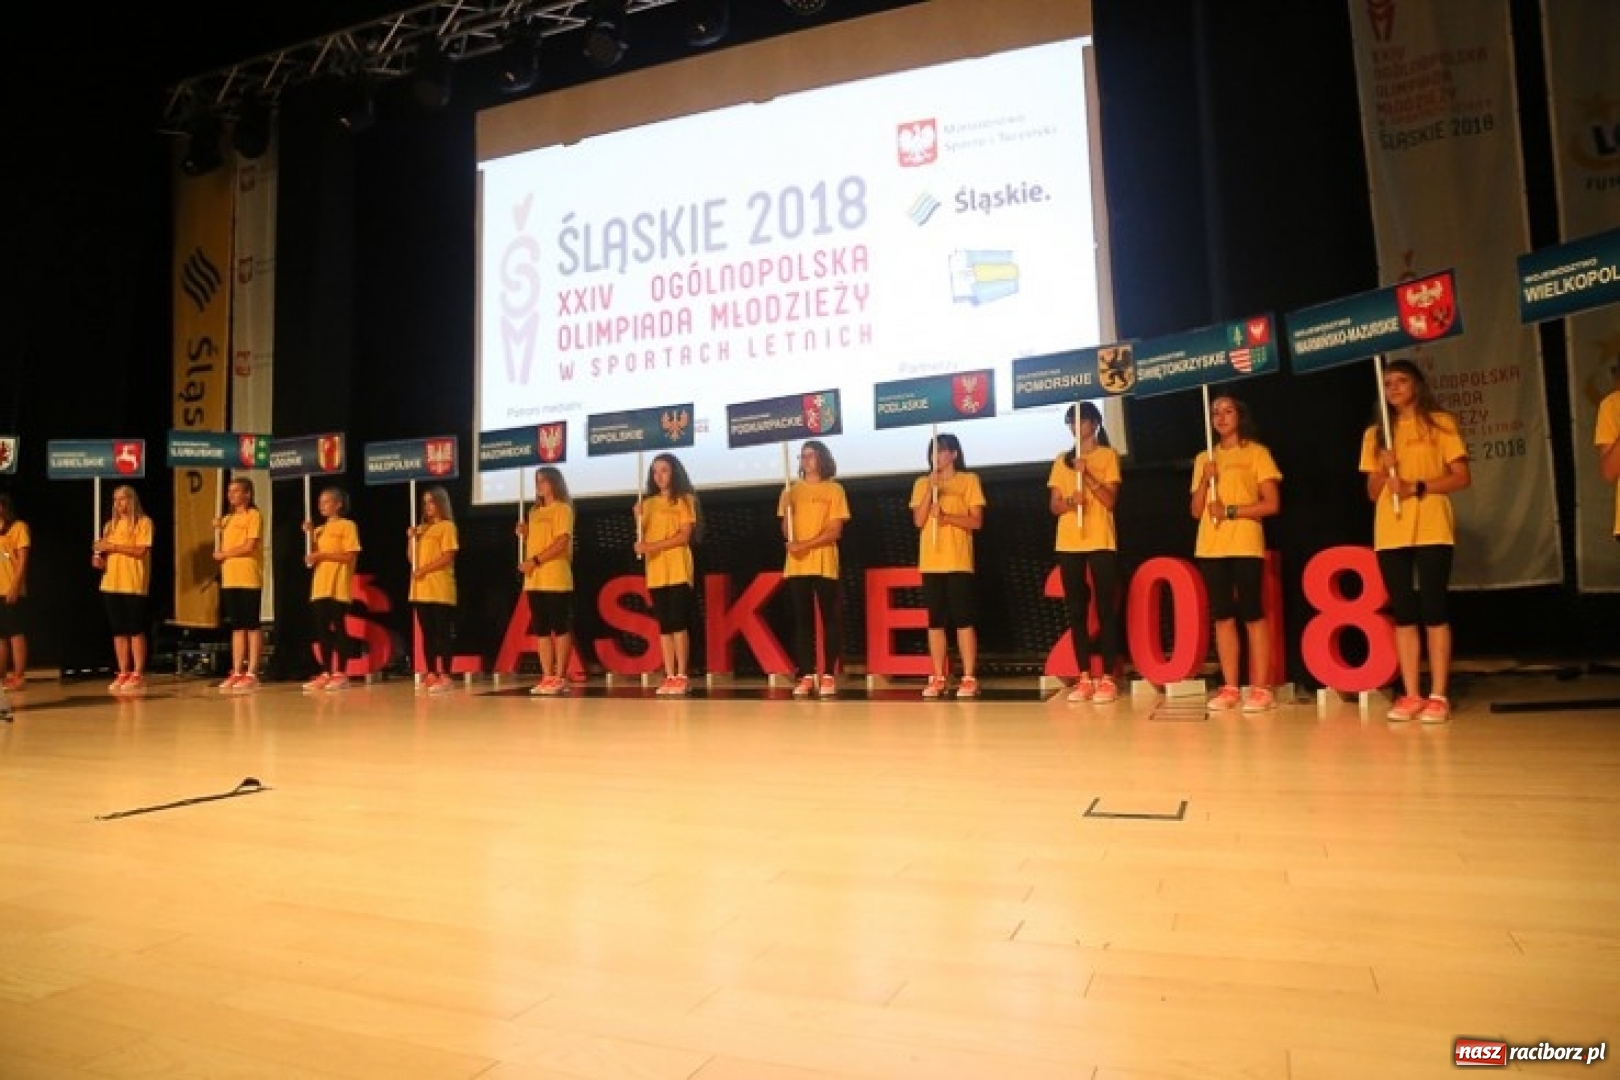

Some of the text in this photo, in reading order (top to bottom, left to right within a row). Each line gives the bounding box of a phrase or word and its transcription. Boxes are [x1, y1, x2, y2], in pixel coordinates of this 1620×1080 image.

[557, 174, 868, 276] ŚLĄSKIE 2018
[954, 181, 1052, 216] Śląskie.
[557, 244, 870, 317] XXIV OGÓLNOPOLSKA
[557, 280, 871, 352] OLIMPIADA MŁODZIEŻY
[558, 323, 873, 381] W SPORTACH LETNICH
[1016, 372, 1092, 394] POMORSKIE
